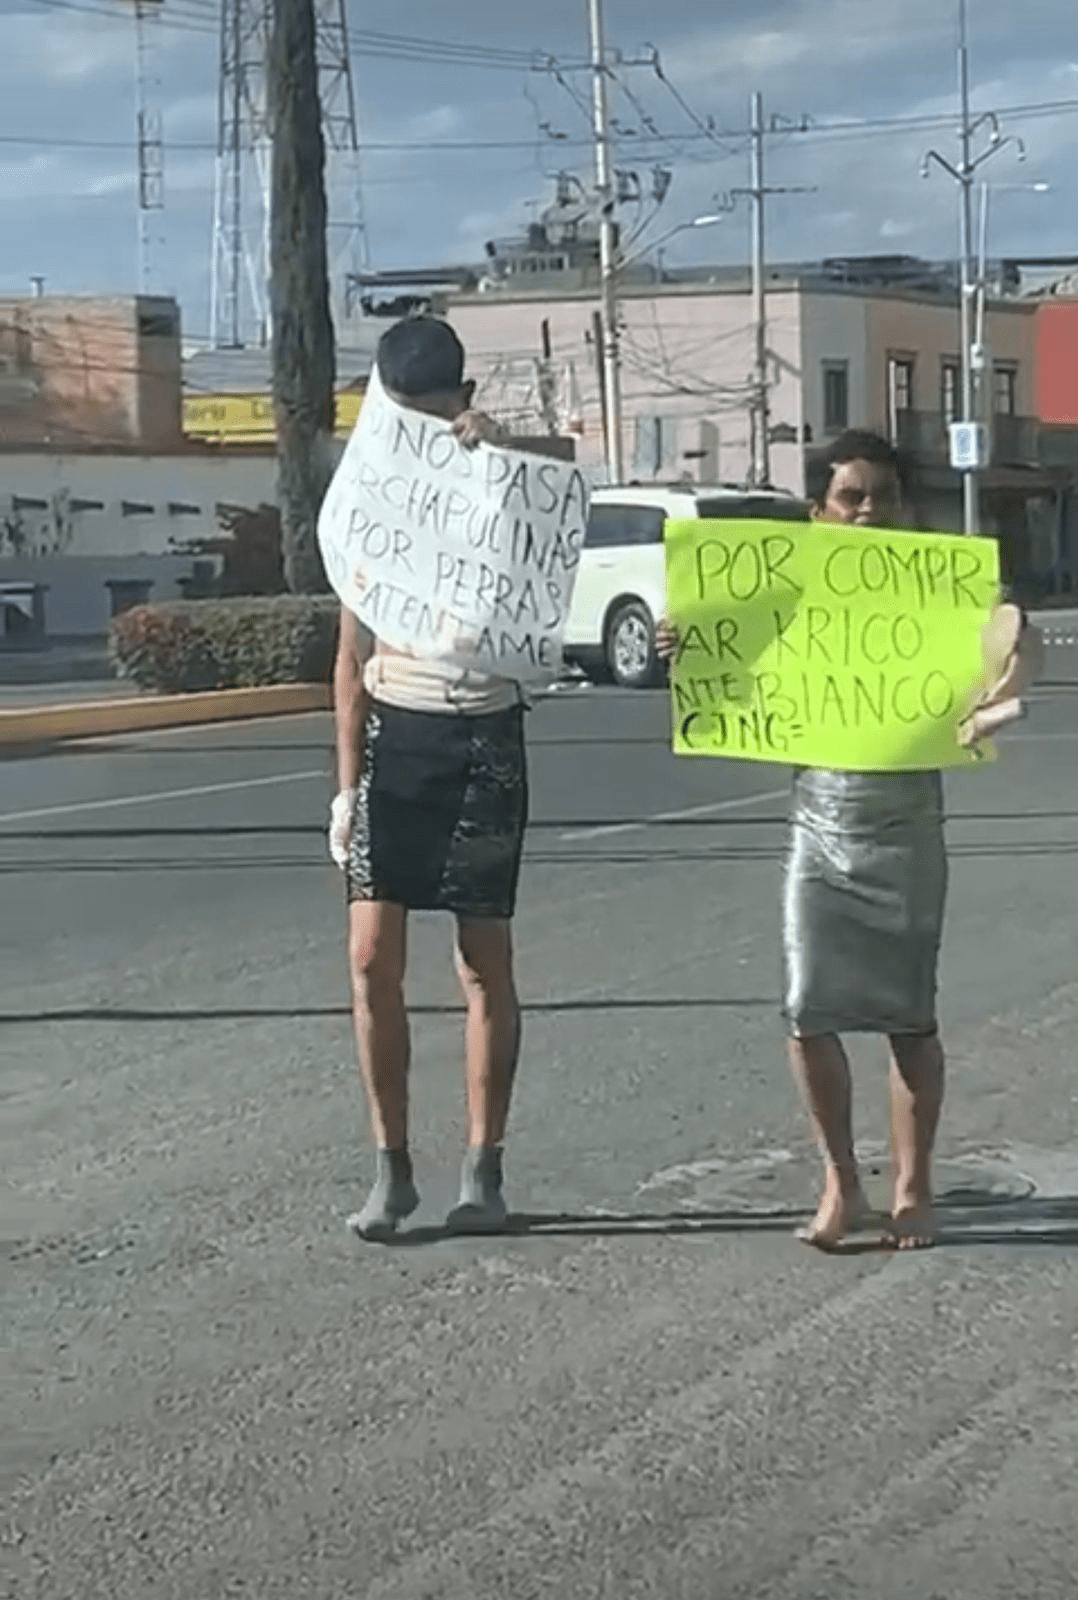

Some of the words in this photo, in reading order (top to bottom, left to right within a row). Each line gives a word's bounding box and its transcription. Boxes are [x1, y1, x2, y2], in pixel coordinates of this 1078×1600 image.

[486, 452, 587, 526] PASA
[346, 507, 413, 573] POR
[696, 535, 804, 601] POR
[433, 551, 562, 630] PERRAS
[675, 617, 742, 666] AR
[773, 605, 923, 667] KRICO
[756, 669, 954, 728] BIANCO
